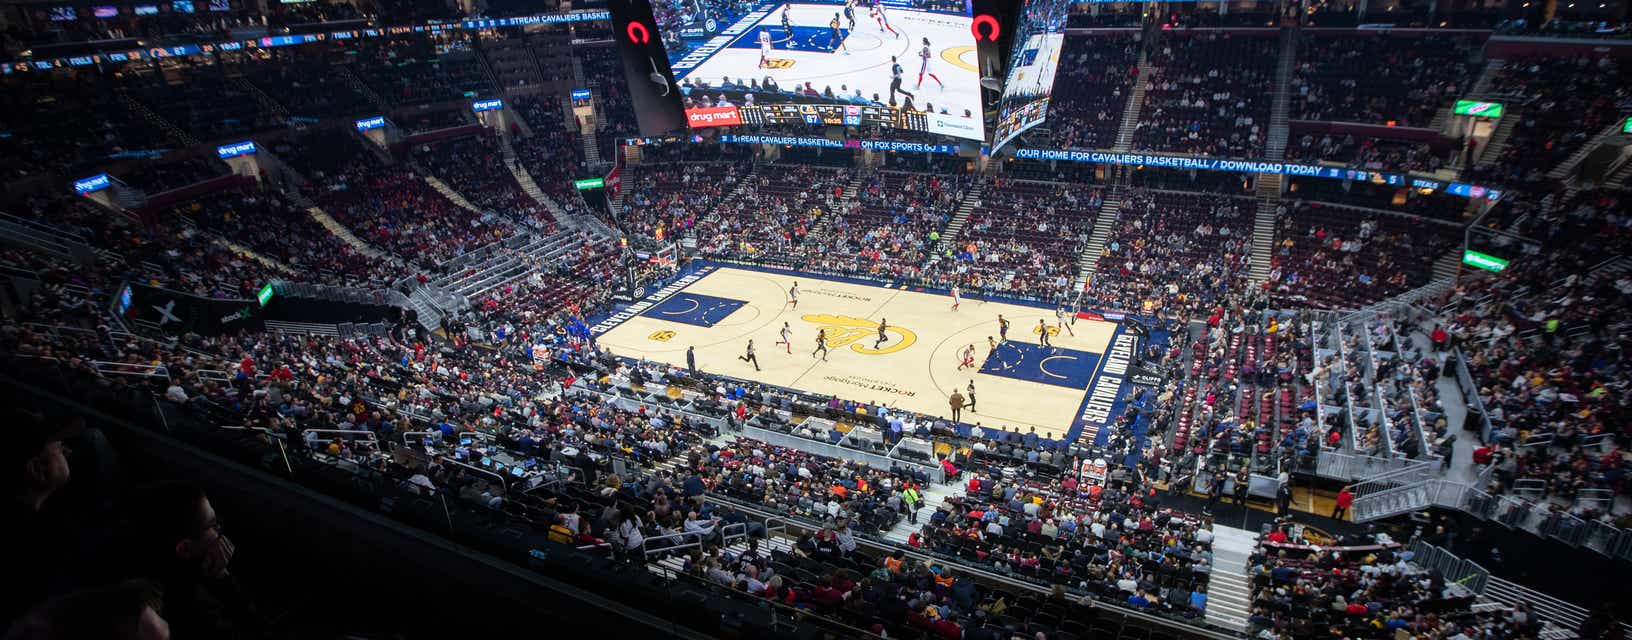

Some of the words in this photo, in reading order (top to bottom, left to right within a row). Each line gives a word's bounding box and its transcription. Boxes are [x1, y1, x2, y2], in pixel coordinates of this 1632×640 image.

[510, 15, 540, 25] STREAM
[541, 13, 580, 23] CAVALIERS
[473, 101, 487, 111] drug
[487, 99, 502, 108] mart
[690, 112, 712, 123] drug
[713, 109, 737, 120] mart
[807, 114, 818, 123] 67
[847, 116, 858, 124] 62
[356, 119, 371, 130] drug
[217, 145, 237, 157] drug
[236, 141, 255, 153] mart
[760, 135, 797, 145] CAVALIERS
[797, 138, 843, 148] BASKETBALL
[844, 140, 861, 149] LIVE
[861, 141, 873, 149] ON
[875, 141, 890, 150] FOX
[891, 142, 923, 152] SPORTS
[1042, 150, 1069, 160] HOME
[1071, 151, 1090, 161] FOR
[1091, 152, 1144, 165] CAVALIERS
[1145, 156, 1210, 168] BASKETBALL
[1219, 160, 1282, 174] DOWNLOAD
[1283, 164, 1322, 176] TODAY
[1103, 334, 1134, 375] CLEVELAND
[869, 385, 916, 398] ROCKET
[1081, 375, 1123, 424] CAVALIERS
